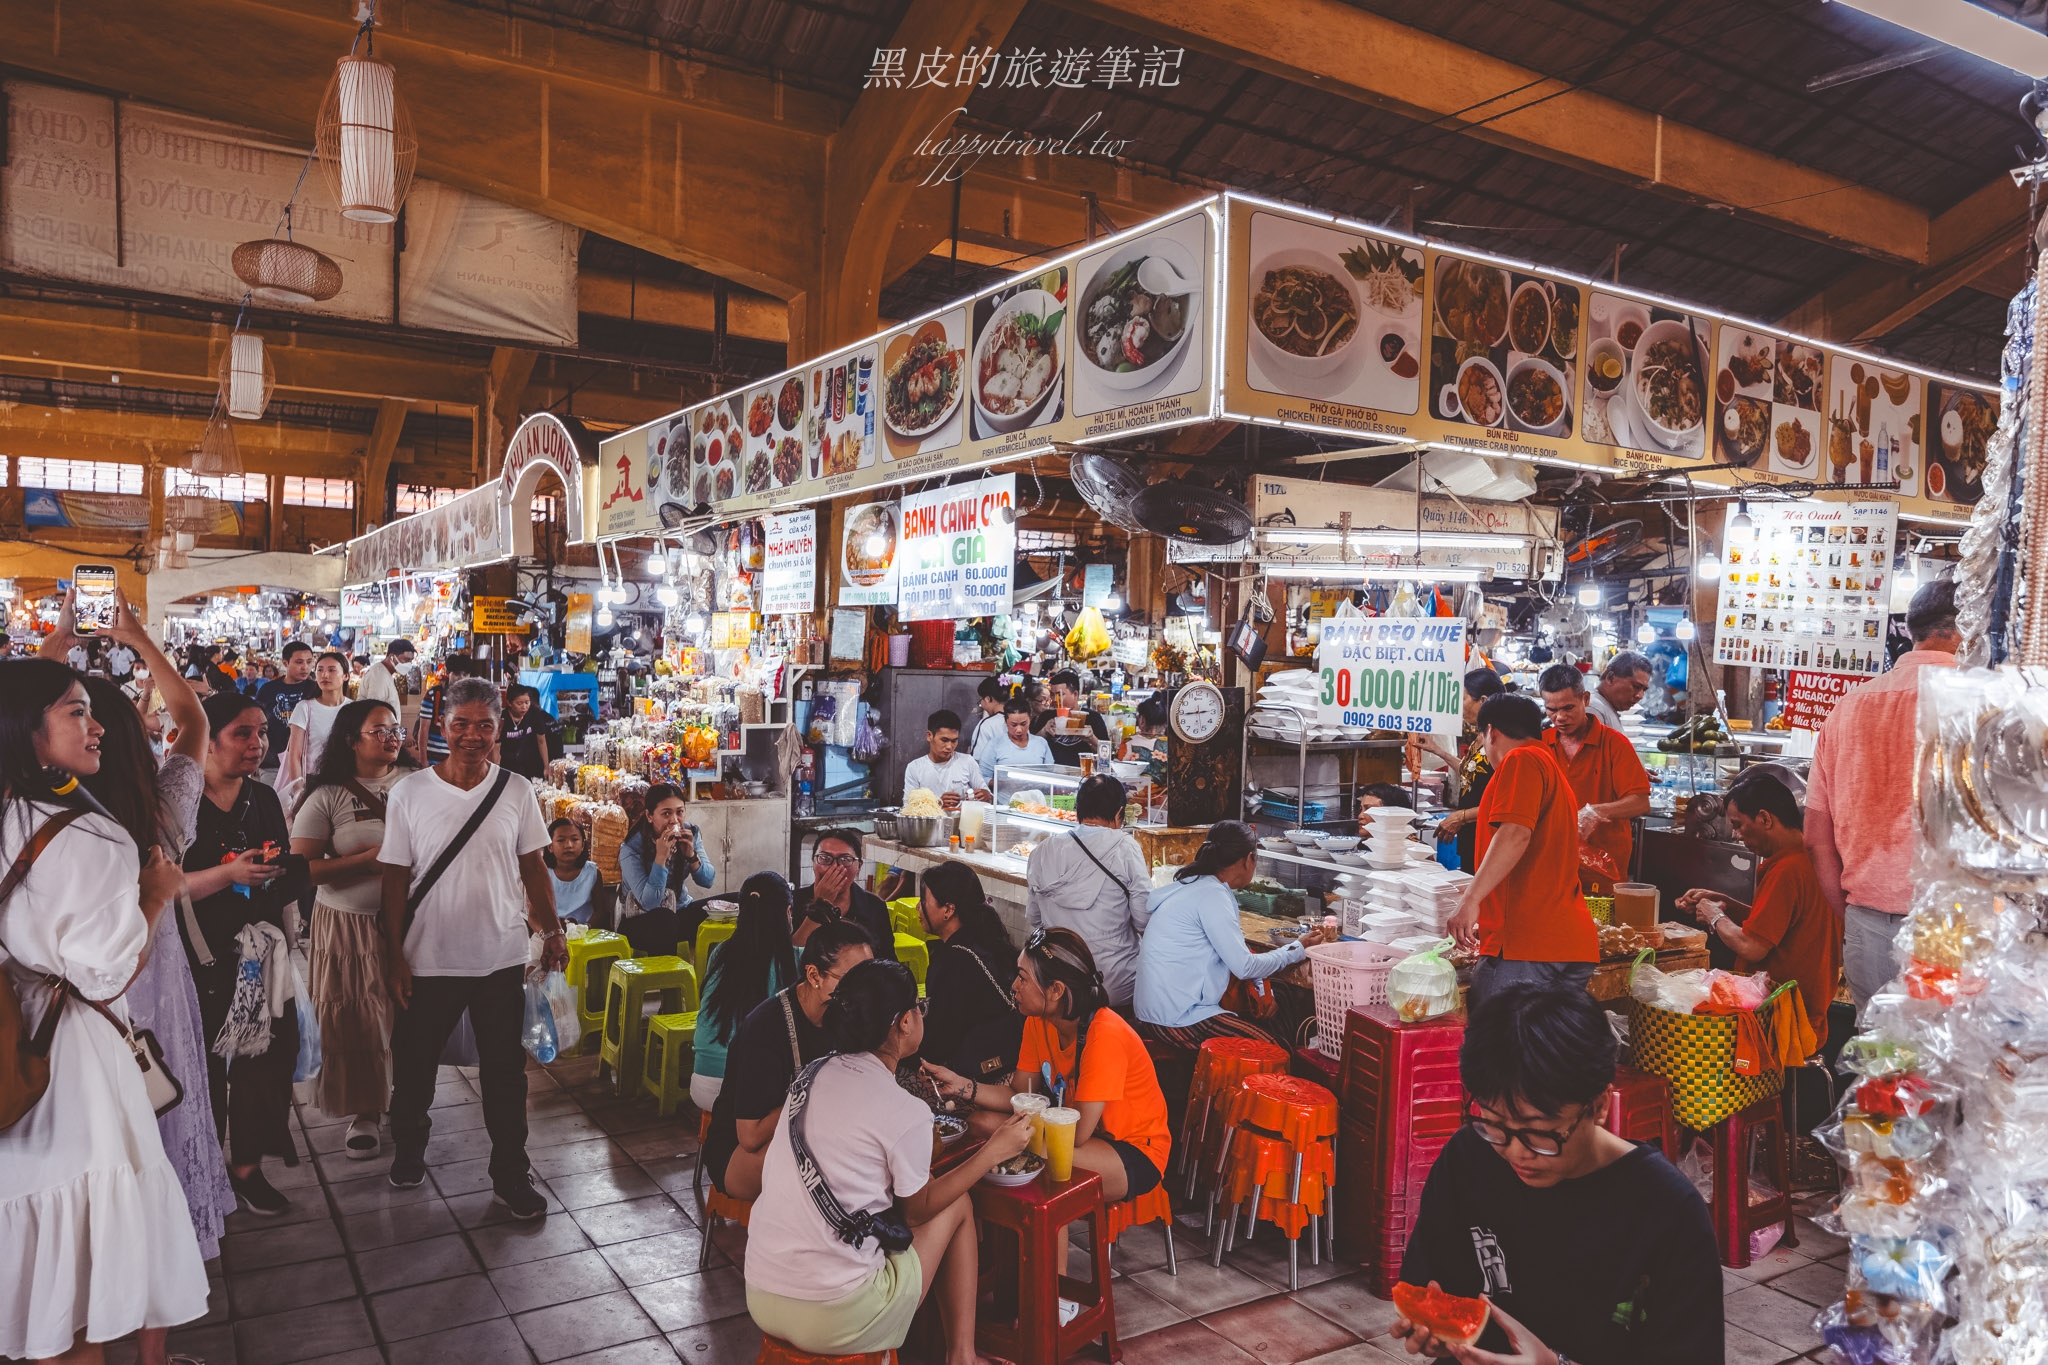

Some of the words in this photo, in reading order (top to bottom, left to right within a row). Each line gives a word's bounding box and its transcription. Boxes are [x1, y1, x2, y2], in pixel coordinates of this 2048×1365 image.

[1085, 418, 1124, 436] VERMICELLI
[1125, 413, 1157, 429] NOODLE,
[1158, 406, 1192, 421] WONTON
[1278, 408, 1315, 423] CHICKEN
[1321, 414, 1343, 426] BEEF
[1345, 418, 1383, 433] NOODLES
[1385, 424, 1407, 435] SOUP
[1310, 402, 1328, 414] PHỞ
[1346, 406, 1365, 420] PHỞ
[1366, 409, 1379, 422] BÒ
[1486, 429, 1501, 440] BÚN
[982, 448, 994, 458] FISH
[995, 440, 1027, 455] VERMICELLI
[1028, 434, 1052, 448] NOODLE
[1443, 434, 1488, 449] VIETNAMESE
[1489, 441, 1509, 452] CRAB
[1510, 444, 1538, 456] NOODLE
[1539, 448, 1558, 458] SOUP
[505, 440, 524, 494] KHU
[525, 426, 540, 460] ĂN
[1613, 457, 1628, 467] RICE
[1629, 460, 1655, 471] NOODLE
[1626, 450, 1644, 461] BÁNH
[1644, 453, 1662, 464] CANH
[912, 463, 930, 474] NOODLE
[941, 498, 977, 534] CANH
[1448, 511, 1467, 524] 1146
[1808, 510, 1841, 520] Oanh
[952, 528, 985, 566] GIÀ
[931, 569, 958, 584] CANH
[965, 565, 1008, 580] 60.000đ
[964, 583, 1006, 597] 50.000đ
[1324, 621, 1373, 641] BÁNH
[1378, 620, 1416, 641] BÈO
[1421, 620, 1463, 642] HUẾ
[1342, 643, 1371, 662] ĐẶC
[1414, 645, 1446, 663] CHẢ
[1795, 673, 1841, 693] NƯỚC
[1343, 711, 1374, 728] 0902
[1378, 714, 1402, 731] 603
[1407, 717, 1432, 733] 528
[800, 1157, 822, 1192] SM
